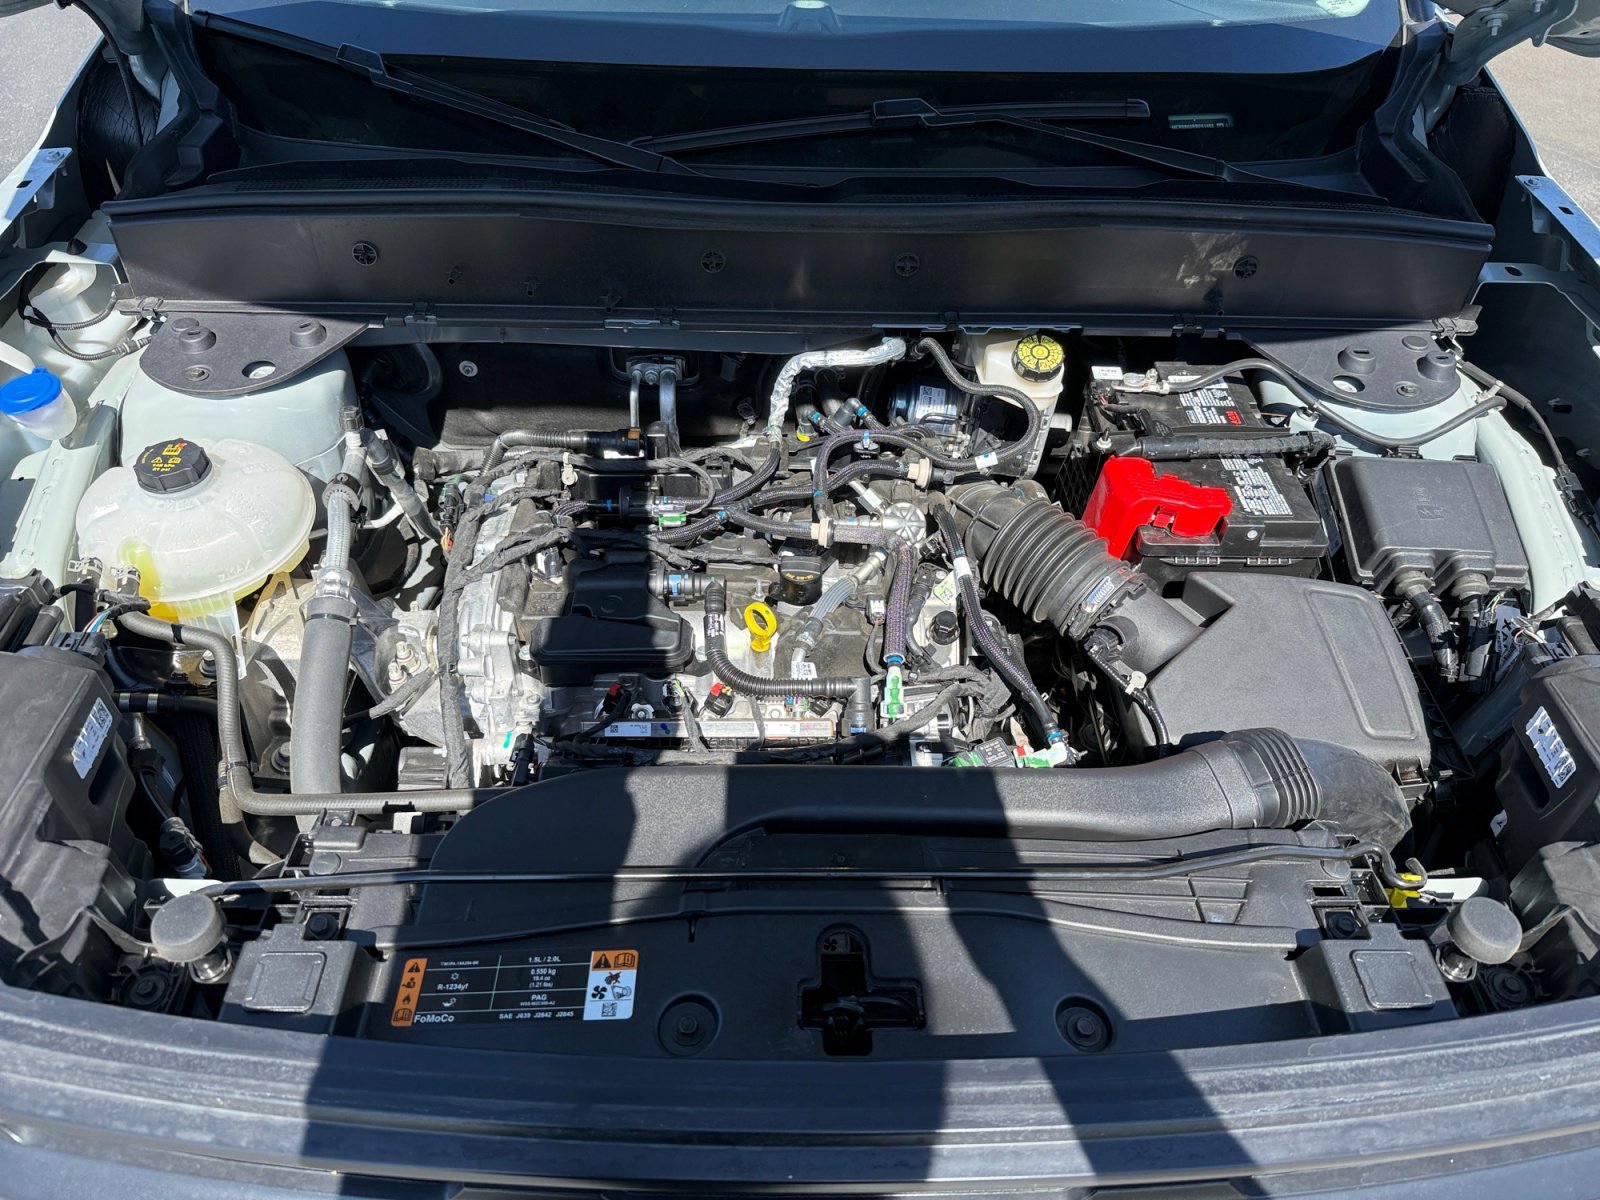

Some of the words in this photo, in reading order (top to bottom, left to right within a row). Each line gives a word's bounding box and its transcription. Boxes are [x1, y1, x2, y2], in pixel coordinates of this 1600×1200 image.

[548, 967, 557, 976] kg
[437, 983, 469, 991] R-1234yf
[413, 1014, 455, 1024] FoMoCo
